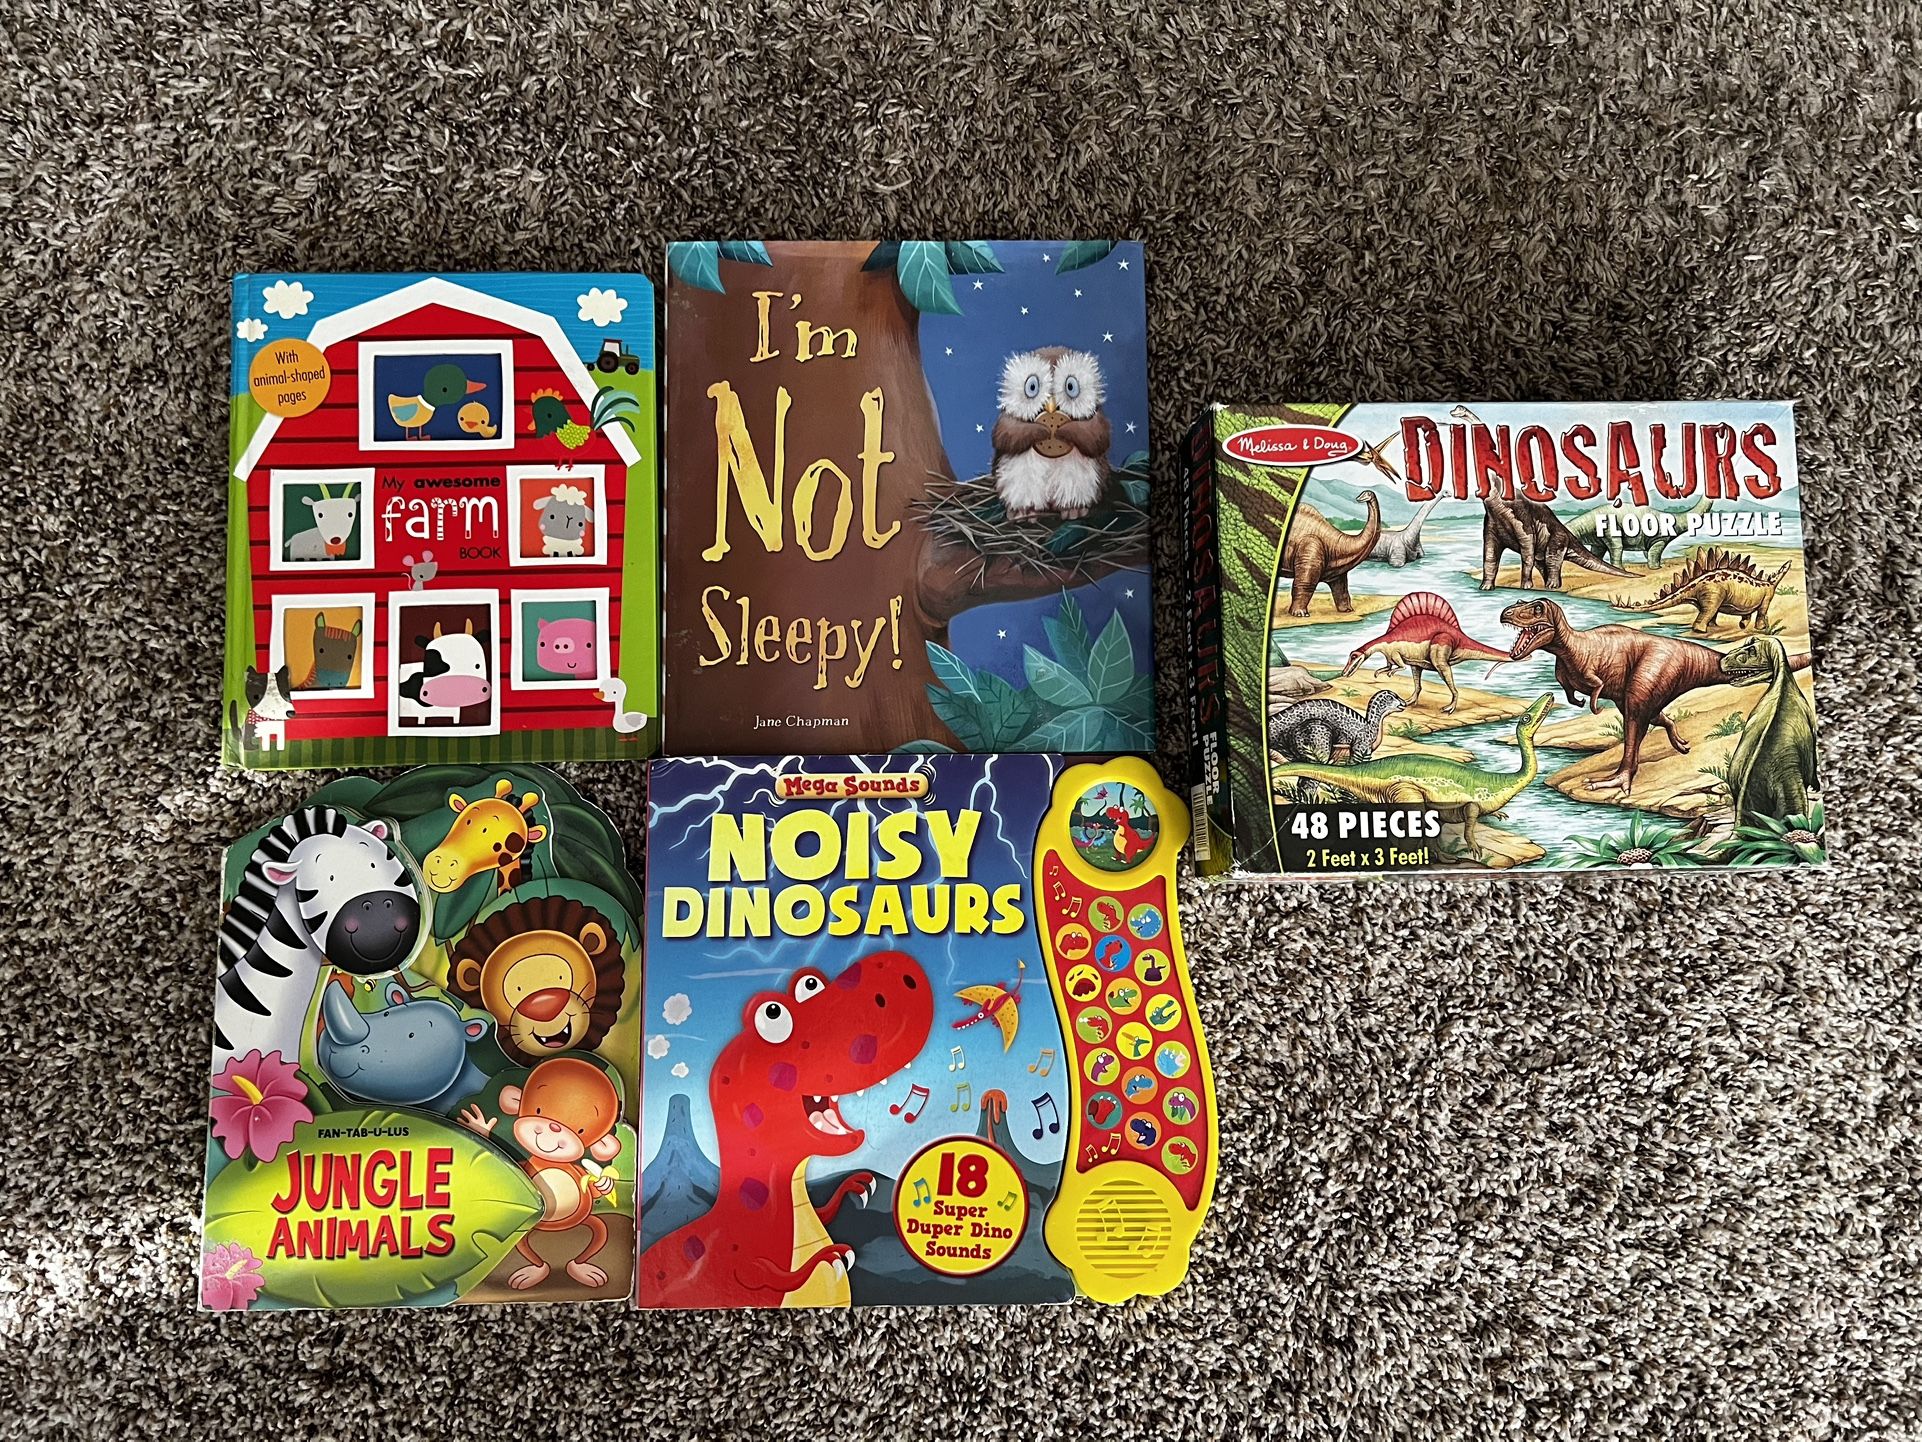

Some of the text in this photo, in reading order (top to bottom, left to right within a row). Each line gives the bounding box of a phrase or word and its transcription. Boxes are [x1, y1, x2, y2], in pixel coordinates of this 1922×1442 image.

[750, 291, 857, 363] I'm
[275, 350, 299, 365] With
[254, 365, 326, 387] animal-shaped
[278, 391, 307, 407] pages
[1237, 436, 1348, 457] Melissa & Doug
[702, 380, 902, 562] Not
[1400, 415, 1782, 507] DINOSAURS
[382, 476, 501, 493] My awesome
[1183, 467, 1190, 493] 48
[381, 495, 499, 542] farm
[1183, 496, 1191, 562] Pieces
[1595, 511, 1784, 538] FLOOR PUZZLE
[459, 546, 502, 560] BOOK
[1191, 419, 1220, 725] DINOSAURS
[1185, 589, 1192, 601] 2
[699, 585, 903, 690] Sleepy!
[1188, 676, 1196, 690] 3
[753, 715, 849, 730] Jane Chapman
[1202, 734, 1214, 806] PUZZLE
[1209, 731, 1220, 795] FLOOR
[783, 775, 920, 797] Mega Sounds
[1291, 810, 1441, 840] 48 PIECES
[708, 809, 982, 882] NOISY
[1306, 847, 1430, 868] 2 Feet x 3 Feet!
[661, 883, 1025, 938] DINOSAURS
[317, 1127, 409, 1139] FAN-TAB-U-LUS
[271, 1147, 455, 1213] JUNGLE
[936, 1152, 989, 1198] 18
[933, 1200, 988, 1221] Super
[267, 1213, 456, 1260] ANIMALS
[906, 1218, 1013, 1239] Duper Dino
[925, 1241, 992, 1260] Sounds
